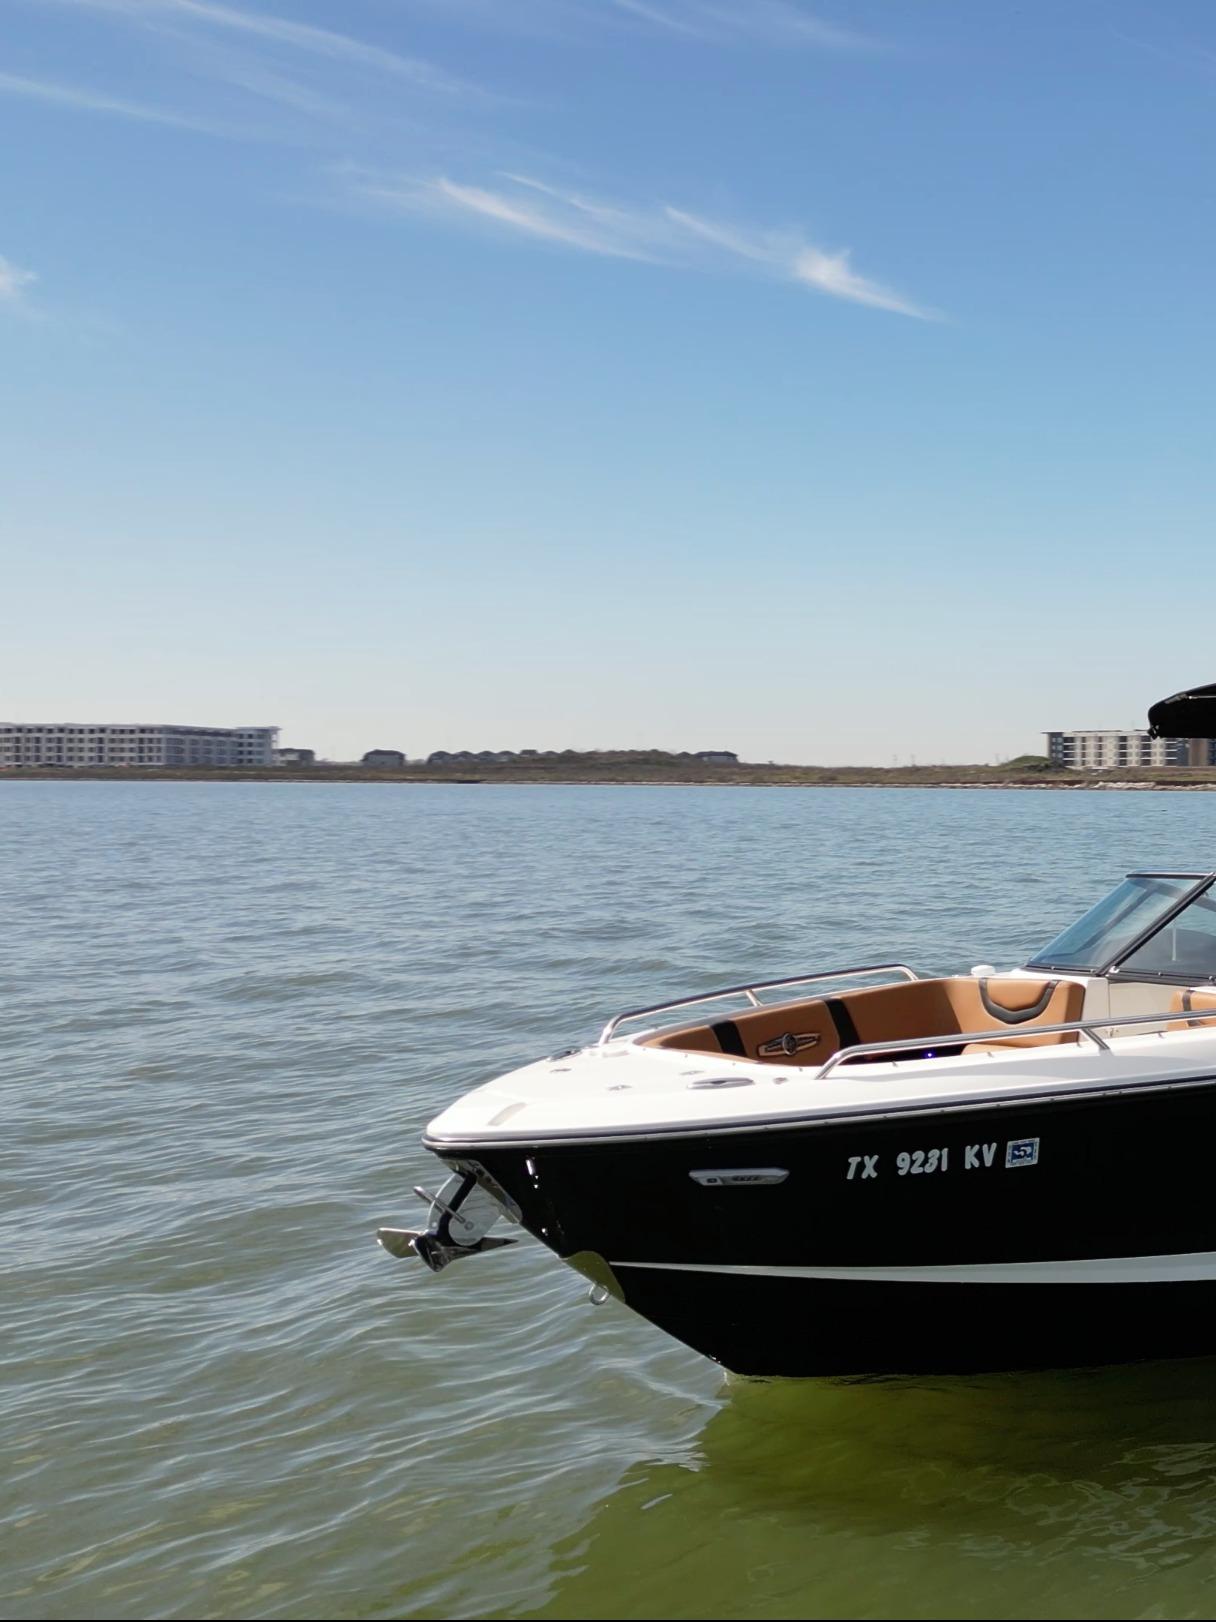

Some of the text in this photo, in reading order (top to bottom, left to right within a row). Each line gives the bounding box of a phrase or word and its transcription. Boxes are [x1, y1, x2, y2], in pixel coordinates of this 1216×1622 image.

[846, 1155, 879, 1180] TX
[896, 1148, 949, 1176] 9231
[964, 1142, 998, 1170] KV
